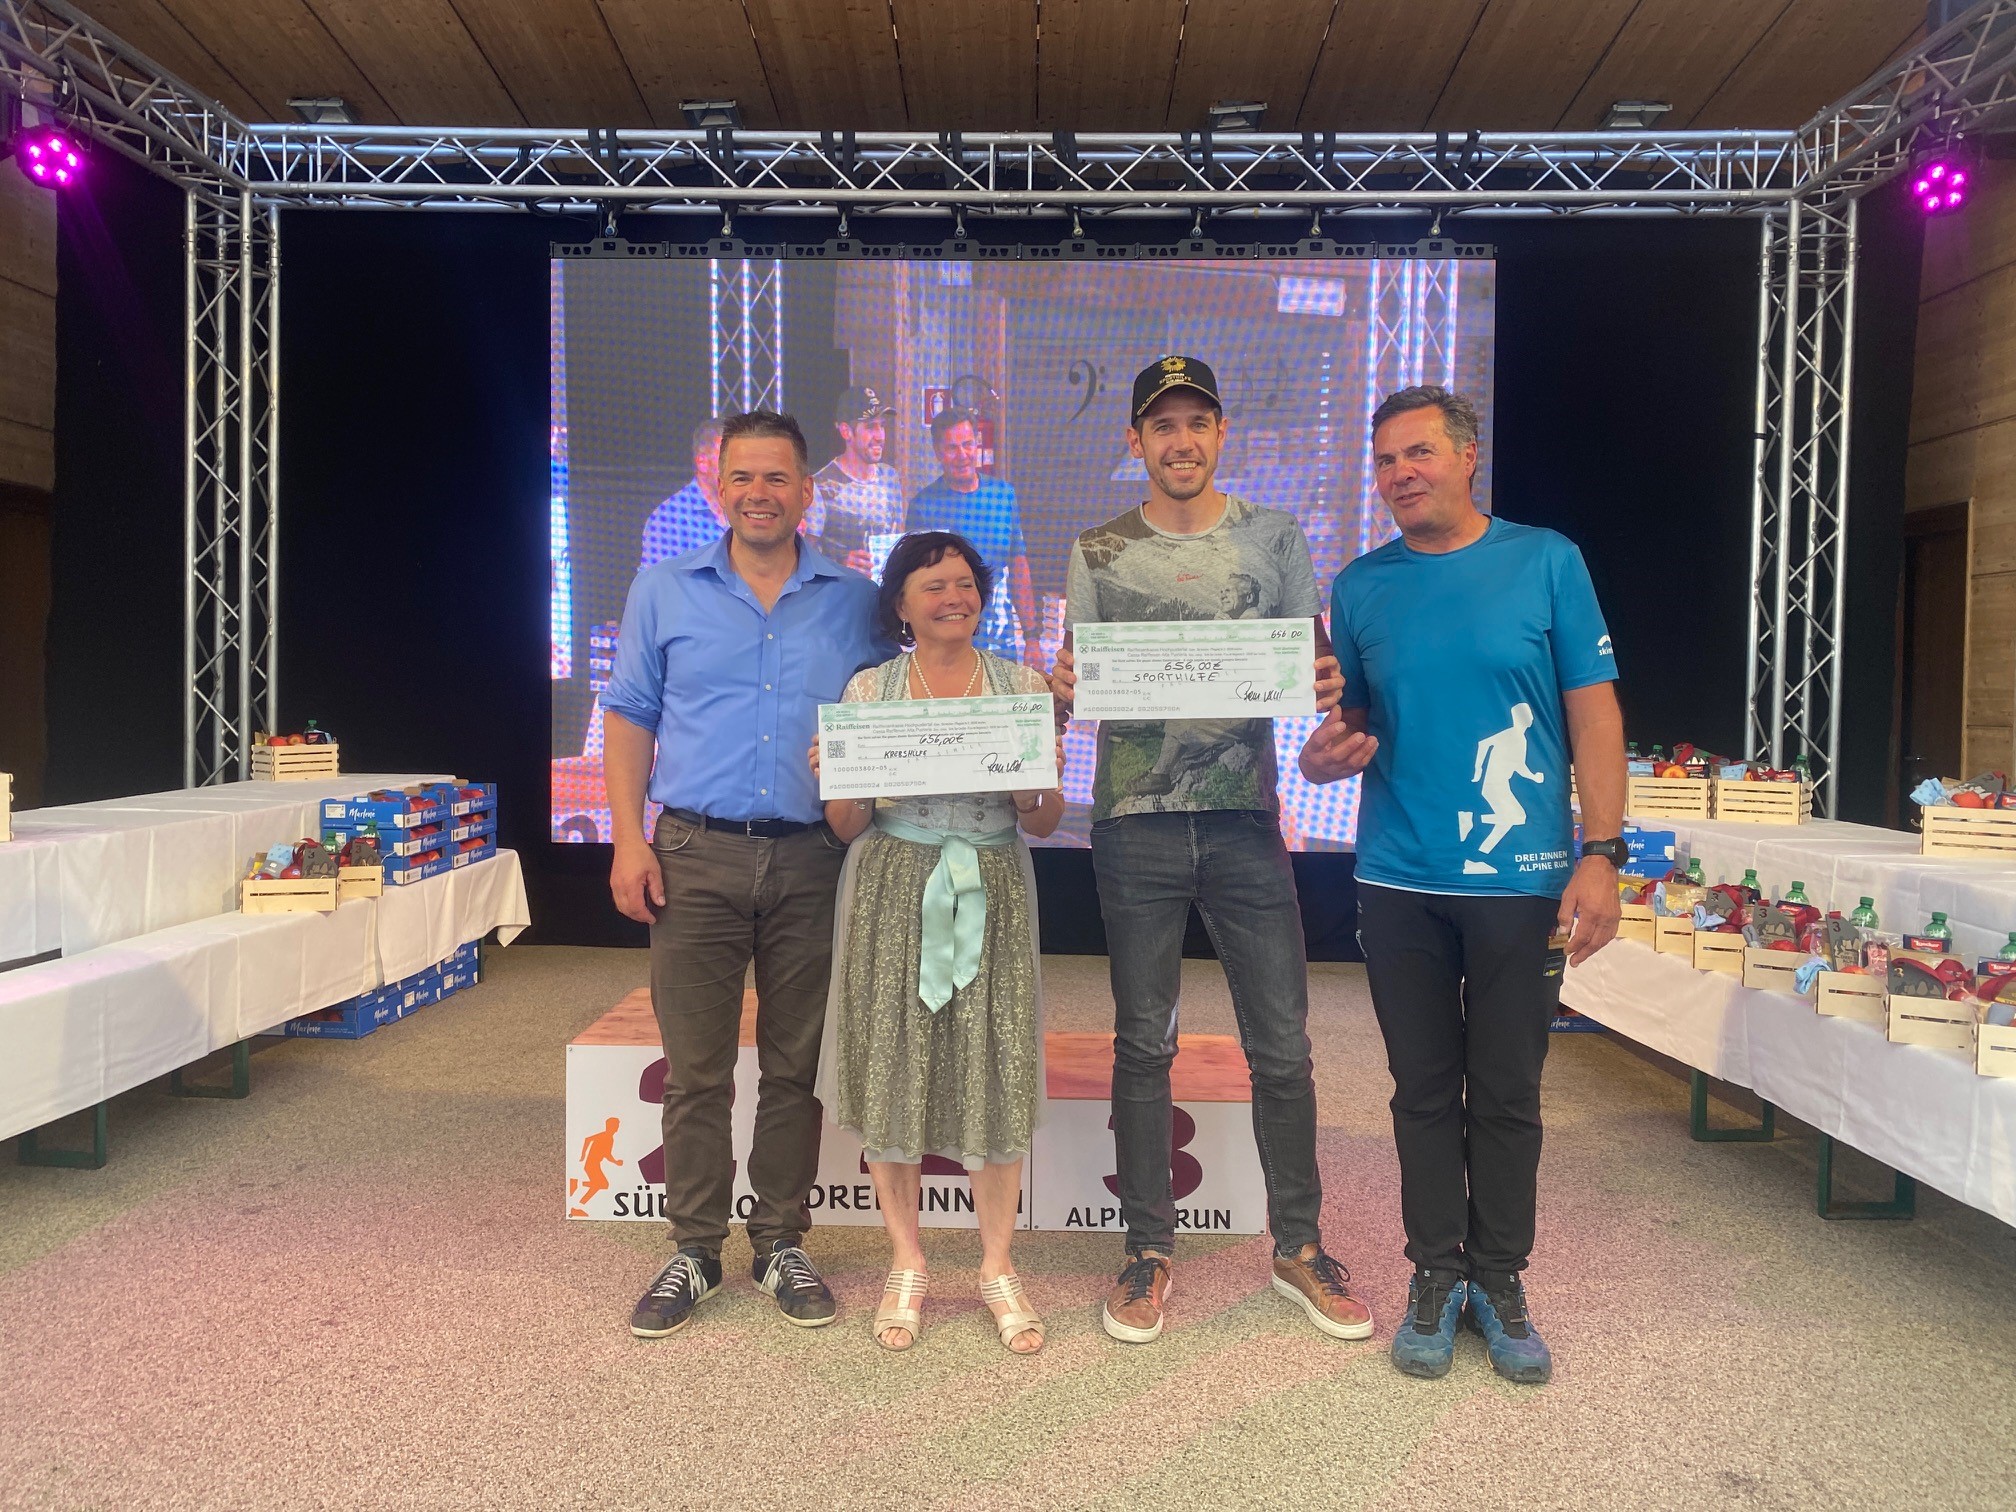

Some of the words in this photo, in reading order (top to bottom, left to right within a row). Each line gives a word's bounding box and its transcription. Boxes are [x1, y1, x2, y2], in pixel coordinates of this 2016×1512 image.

[1132, 672, 1219, 683] SPORTHILFE
[348, 808, 376, 821] Marlene
[1627, 838, 1645, 851] rlene
[1515, 854, 1538, 862] DREI
[1540, 851, 1568, 860] ZINNEN
[1519, 862, 1552, 872] ALPINE
[1759, 909, 1767, 918] 3
[1833, 922, 1841, 932] 3
[290, 1022, 322, 1036] Marlene
[1066, 1207, 1125, 1228] ALPI
[1175, 1209, 1231, 1230] RUN
